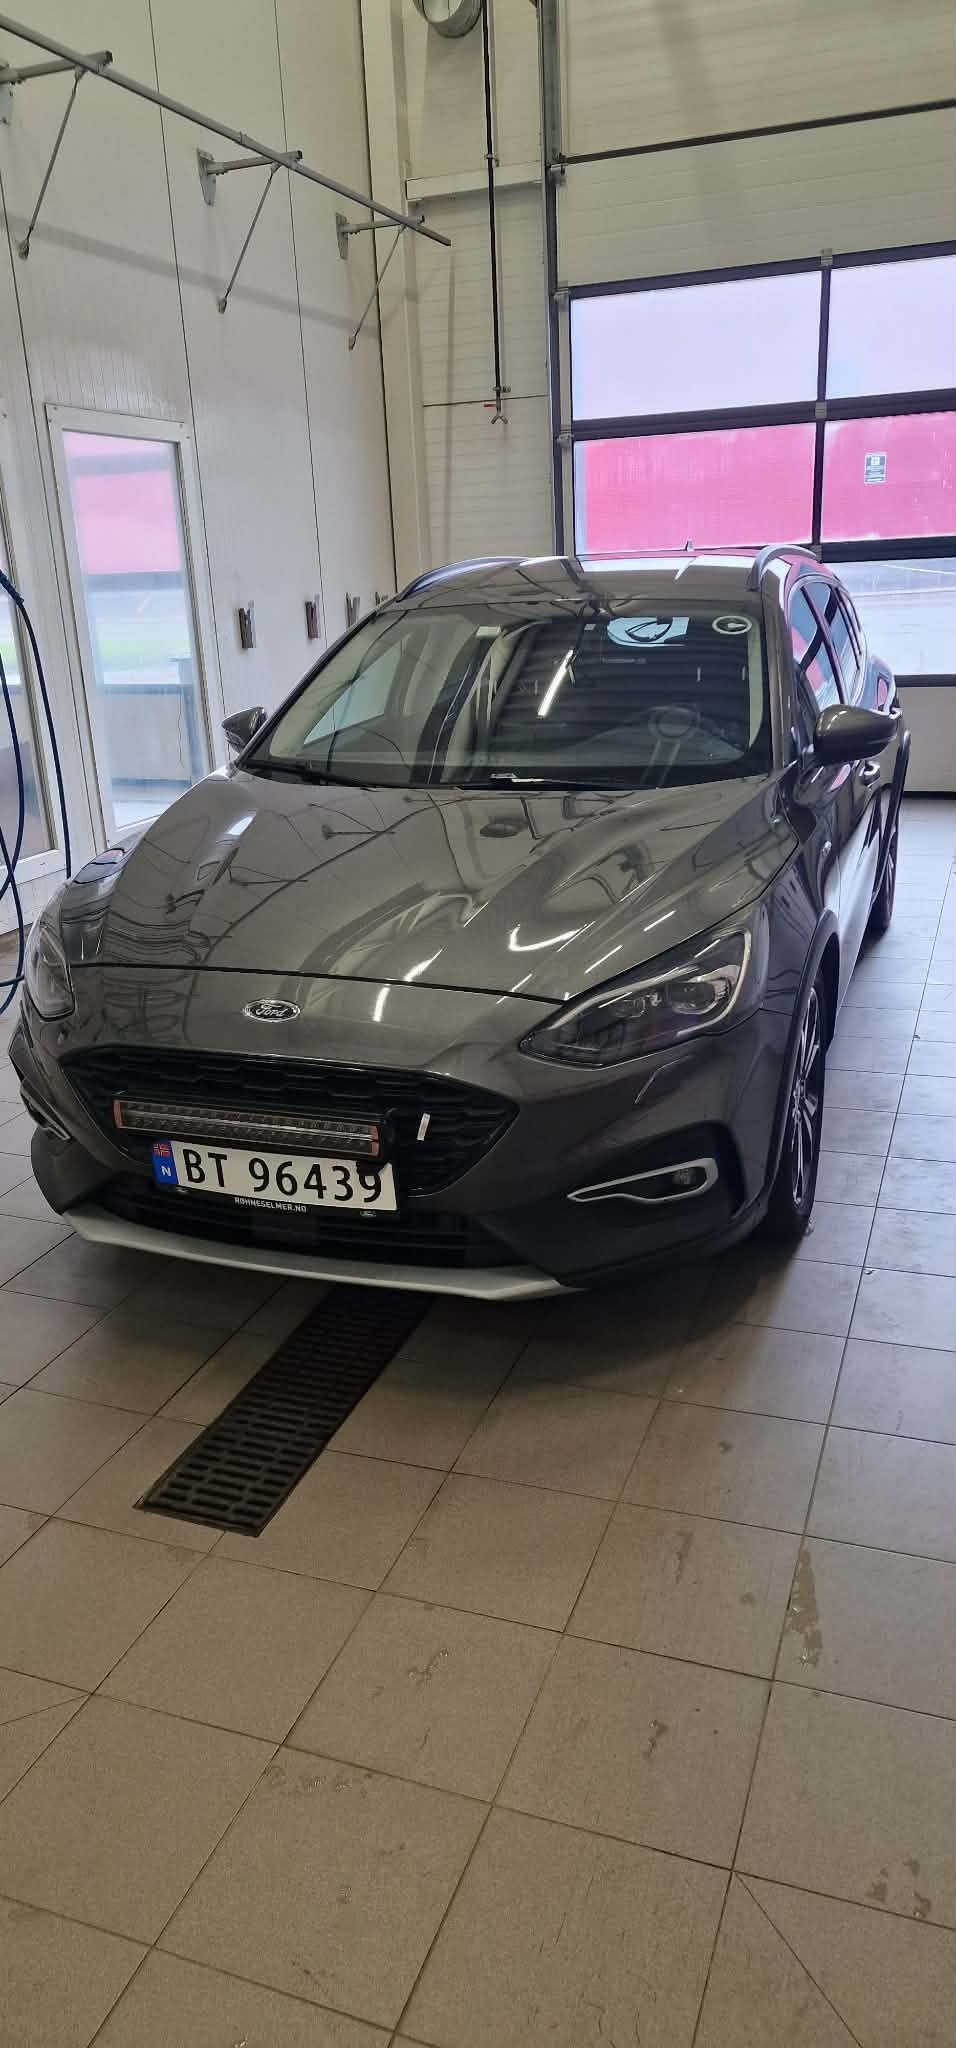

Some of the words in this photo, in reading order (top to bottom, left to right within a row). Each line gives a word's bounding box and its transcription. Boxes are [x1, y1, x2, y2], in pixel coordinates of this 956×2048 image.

[256, 1003, 288, 1017] Ford
[161, 1166, 172, 1177] N
[182, 1149, 228, 1188] BT
[248, 1158, 382, 1203] 96439
